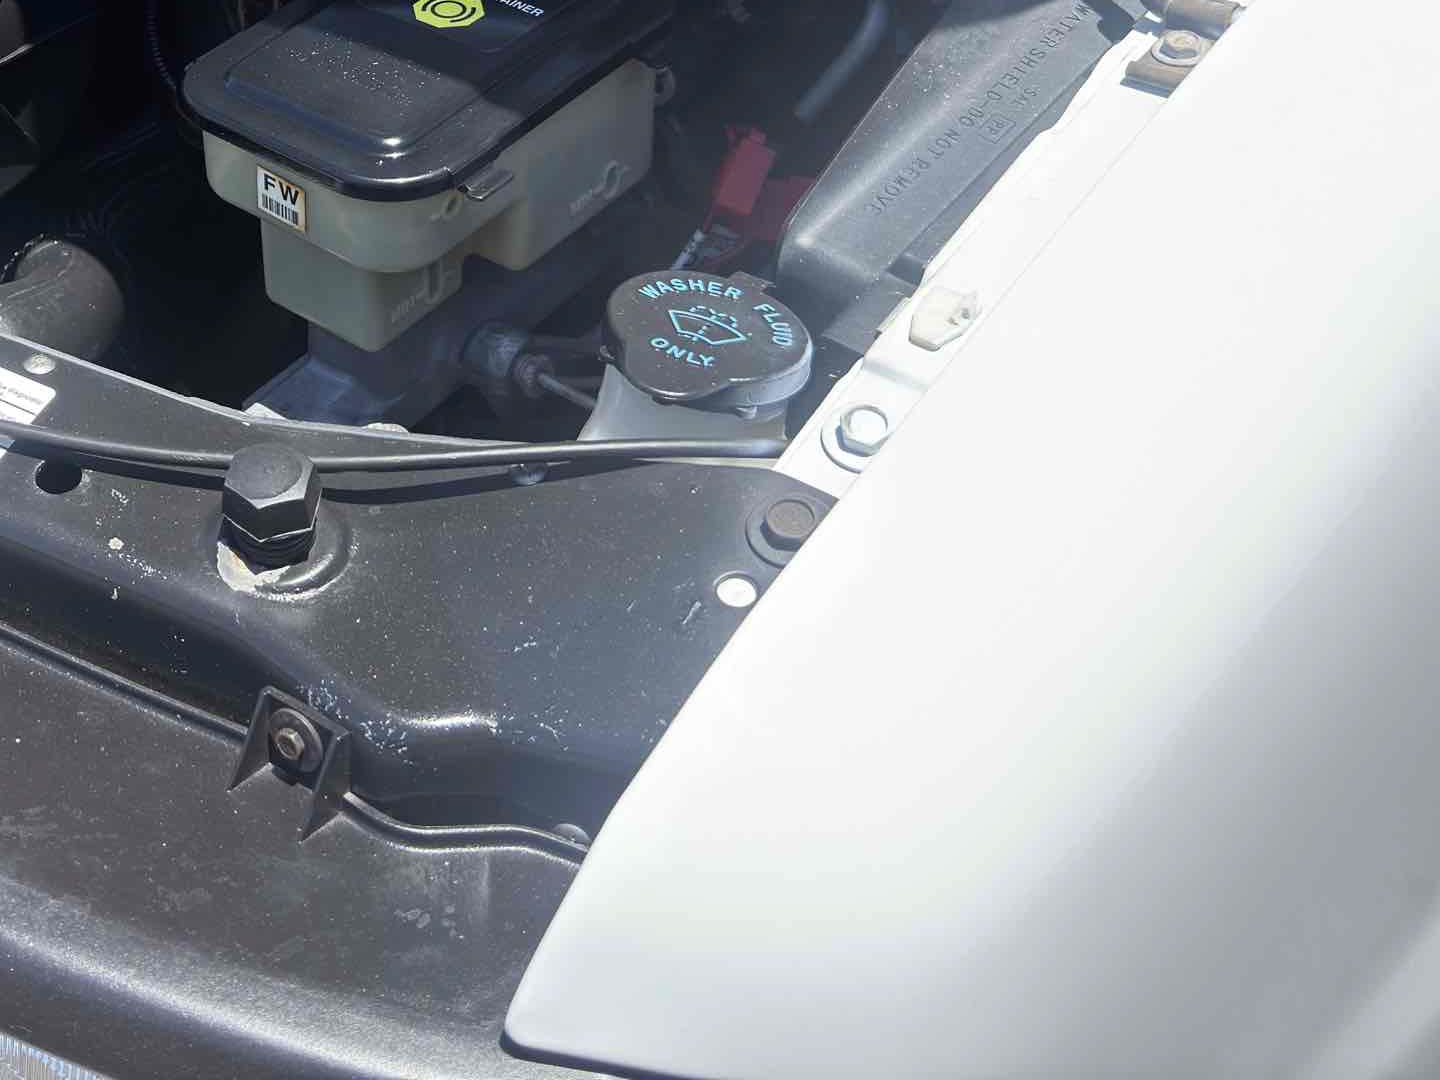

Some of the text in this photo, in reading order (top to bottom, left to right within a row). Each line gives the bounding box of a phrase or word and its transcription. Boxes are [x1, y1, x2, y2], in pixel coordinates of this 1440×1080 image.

[1039, 3, 1091, 49] WATER
[927, 127, 962, 160] NOT
[263, 173, 300, 206] FW
[870, 157, 931, 216] REMOVE
[638, 278, 793, 367] WASHER FLUID ONLY
